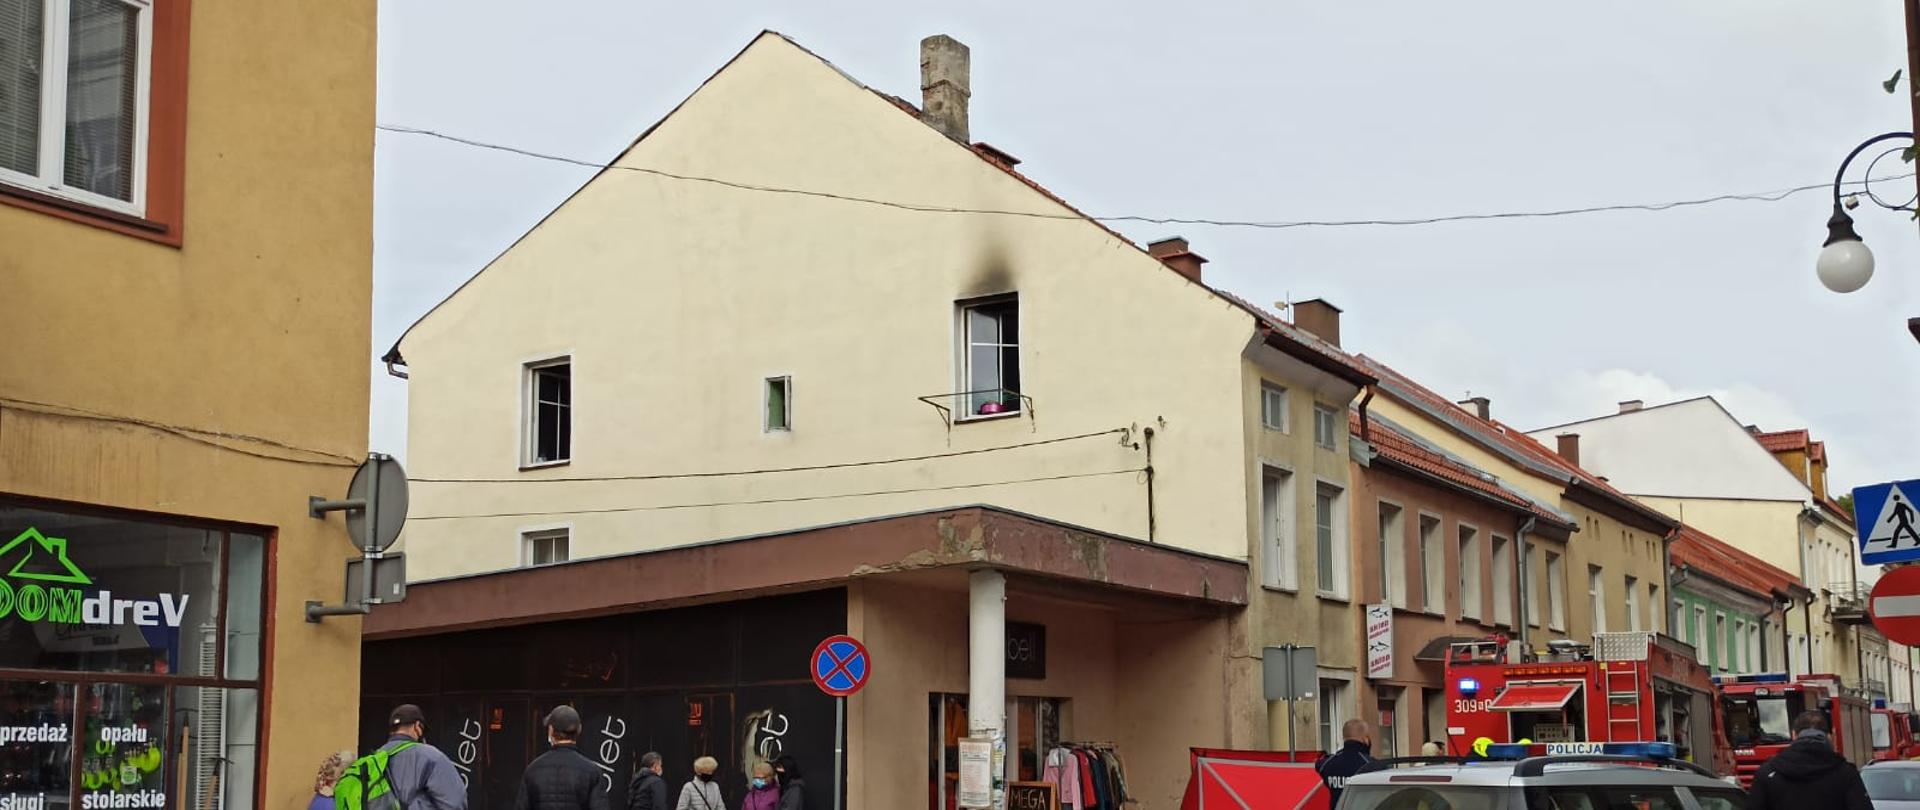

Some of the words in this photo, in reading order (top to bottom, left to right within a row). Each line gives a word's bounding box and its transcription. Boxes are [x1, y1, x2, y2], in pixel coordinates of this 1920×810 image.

[101, 723, 148, 746] opału
[1547, 743, 1604, 754] POLICJA
[81, 788, 166, 809] stolarskie
[1010, 788, 1046, 810] MEGA
